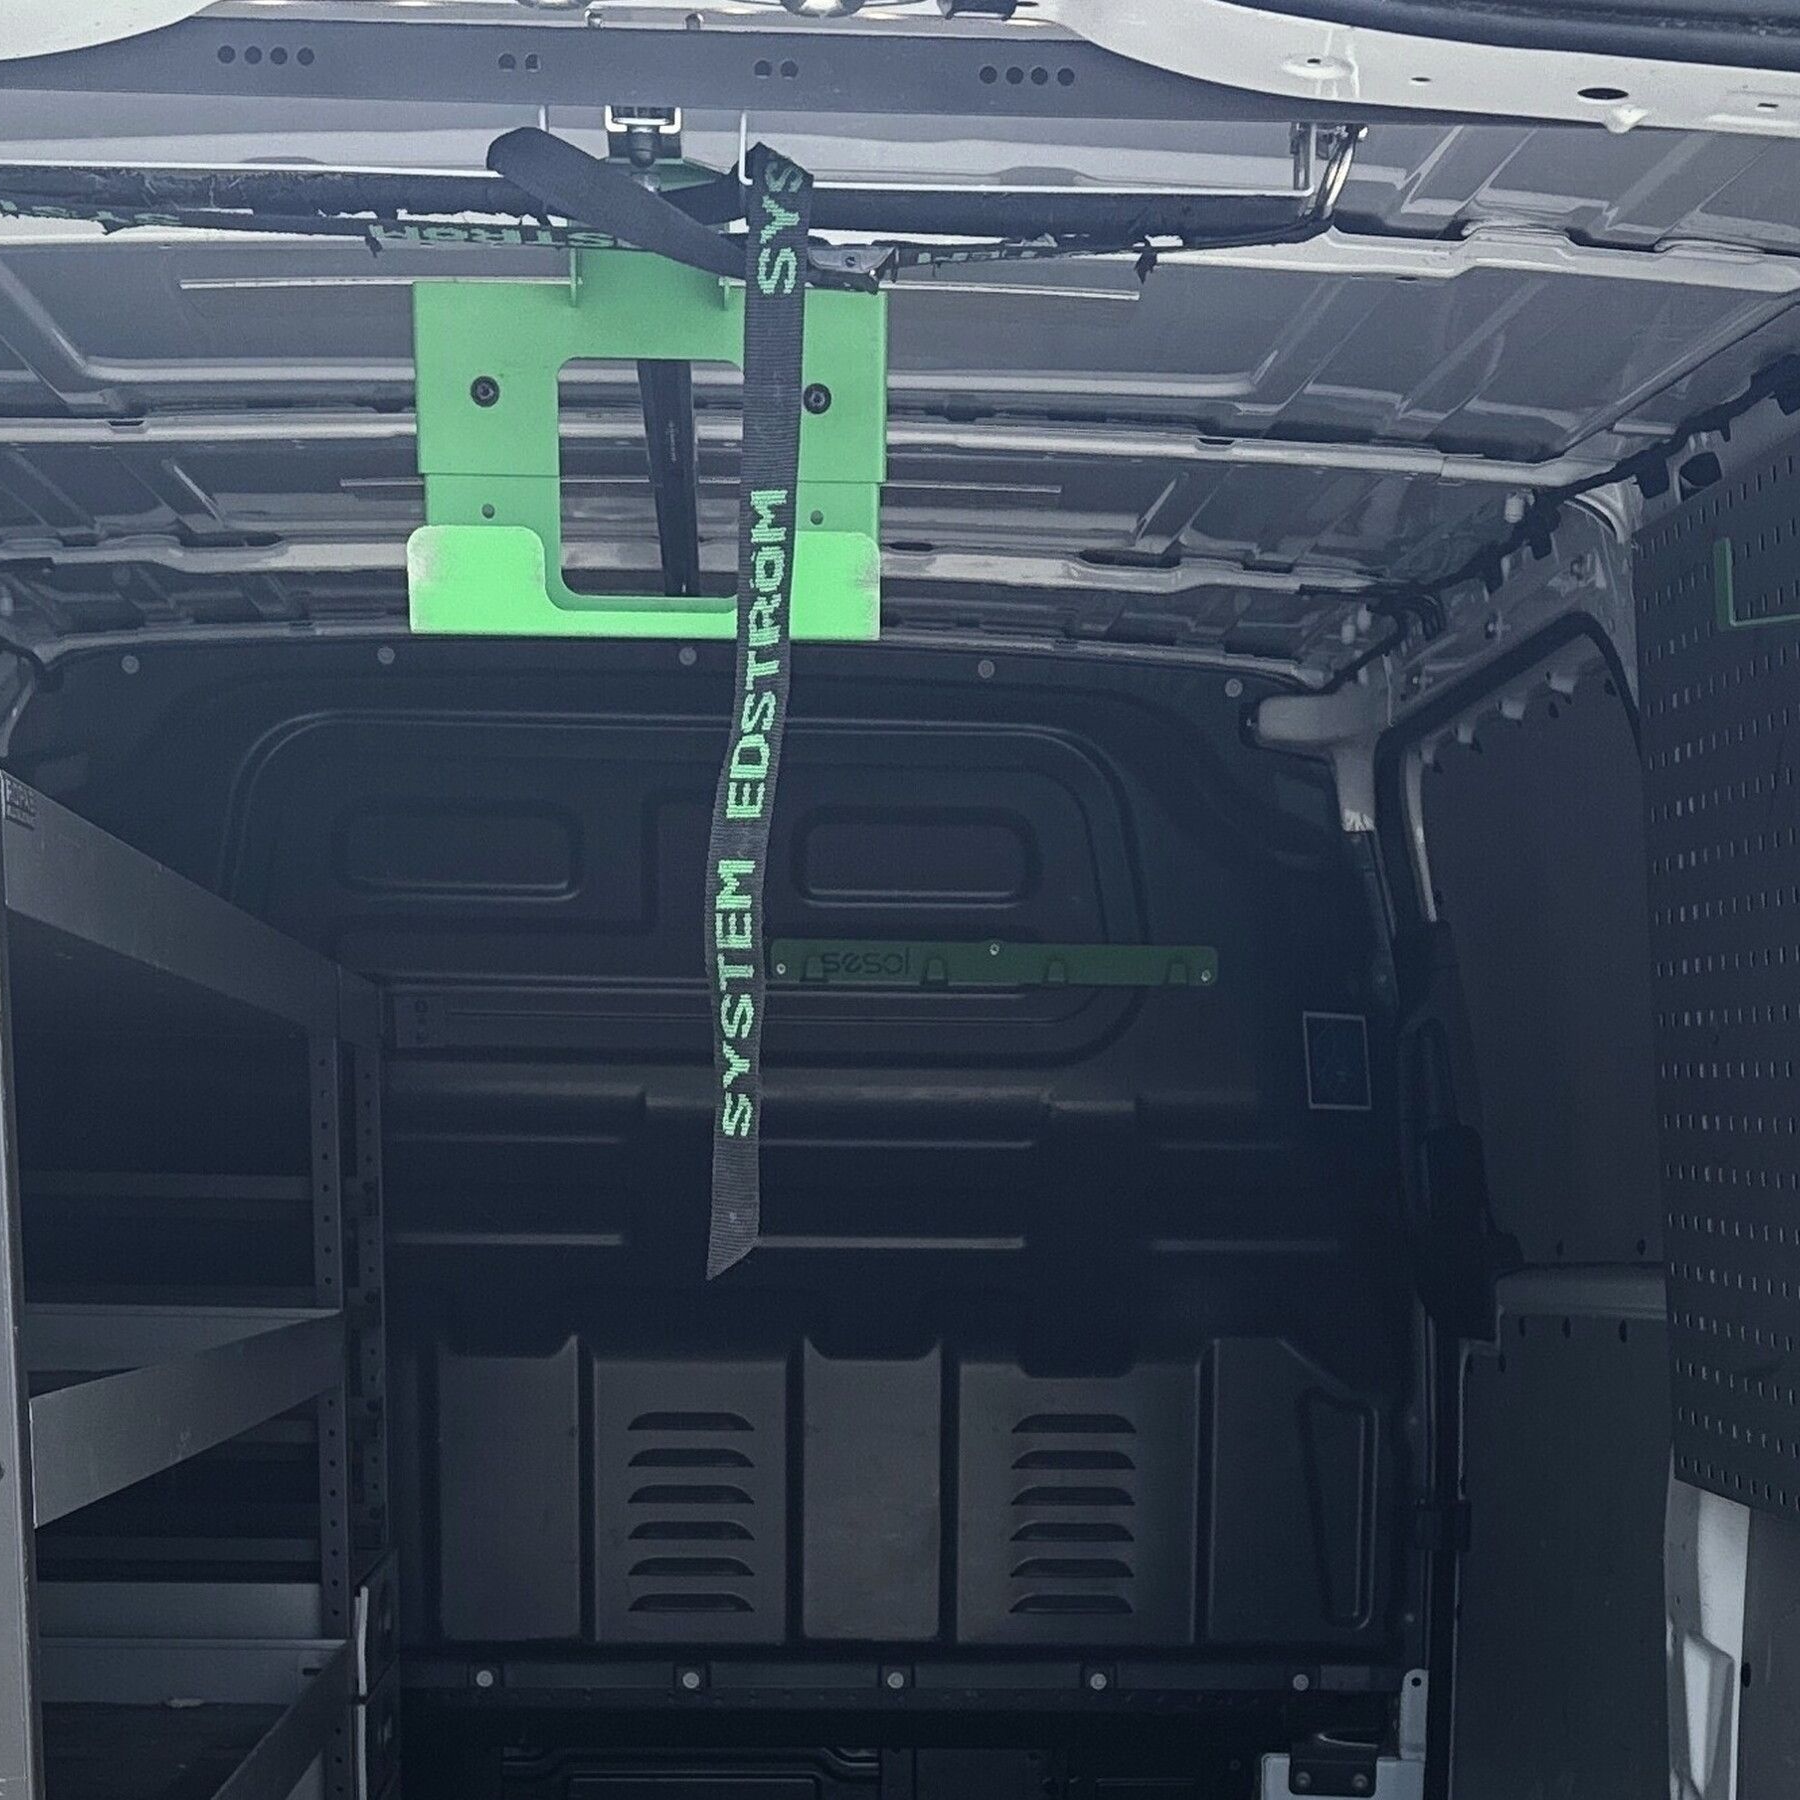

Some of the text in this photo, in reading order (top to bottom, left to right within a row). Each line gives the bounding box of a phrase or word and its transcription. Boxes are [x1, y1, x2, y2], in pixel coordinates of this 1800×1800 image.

[715, 859, 756, 1137] SYSTEM
[756, 161, 804, 295] SYS
[821, 947, 909, 976] sesol
